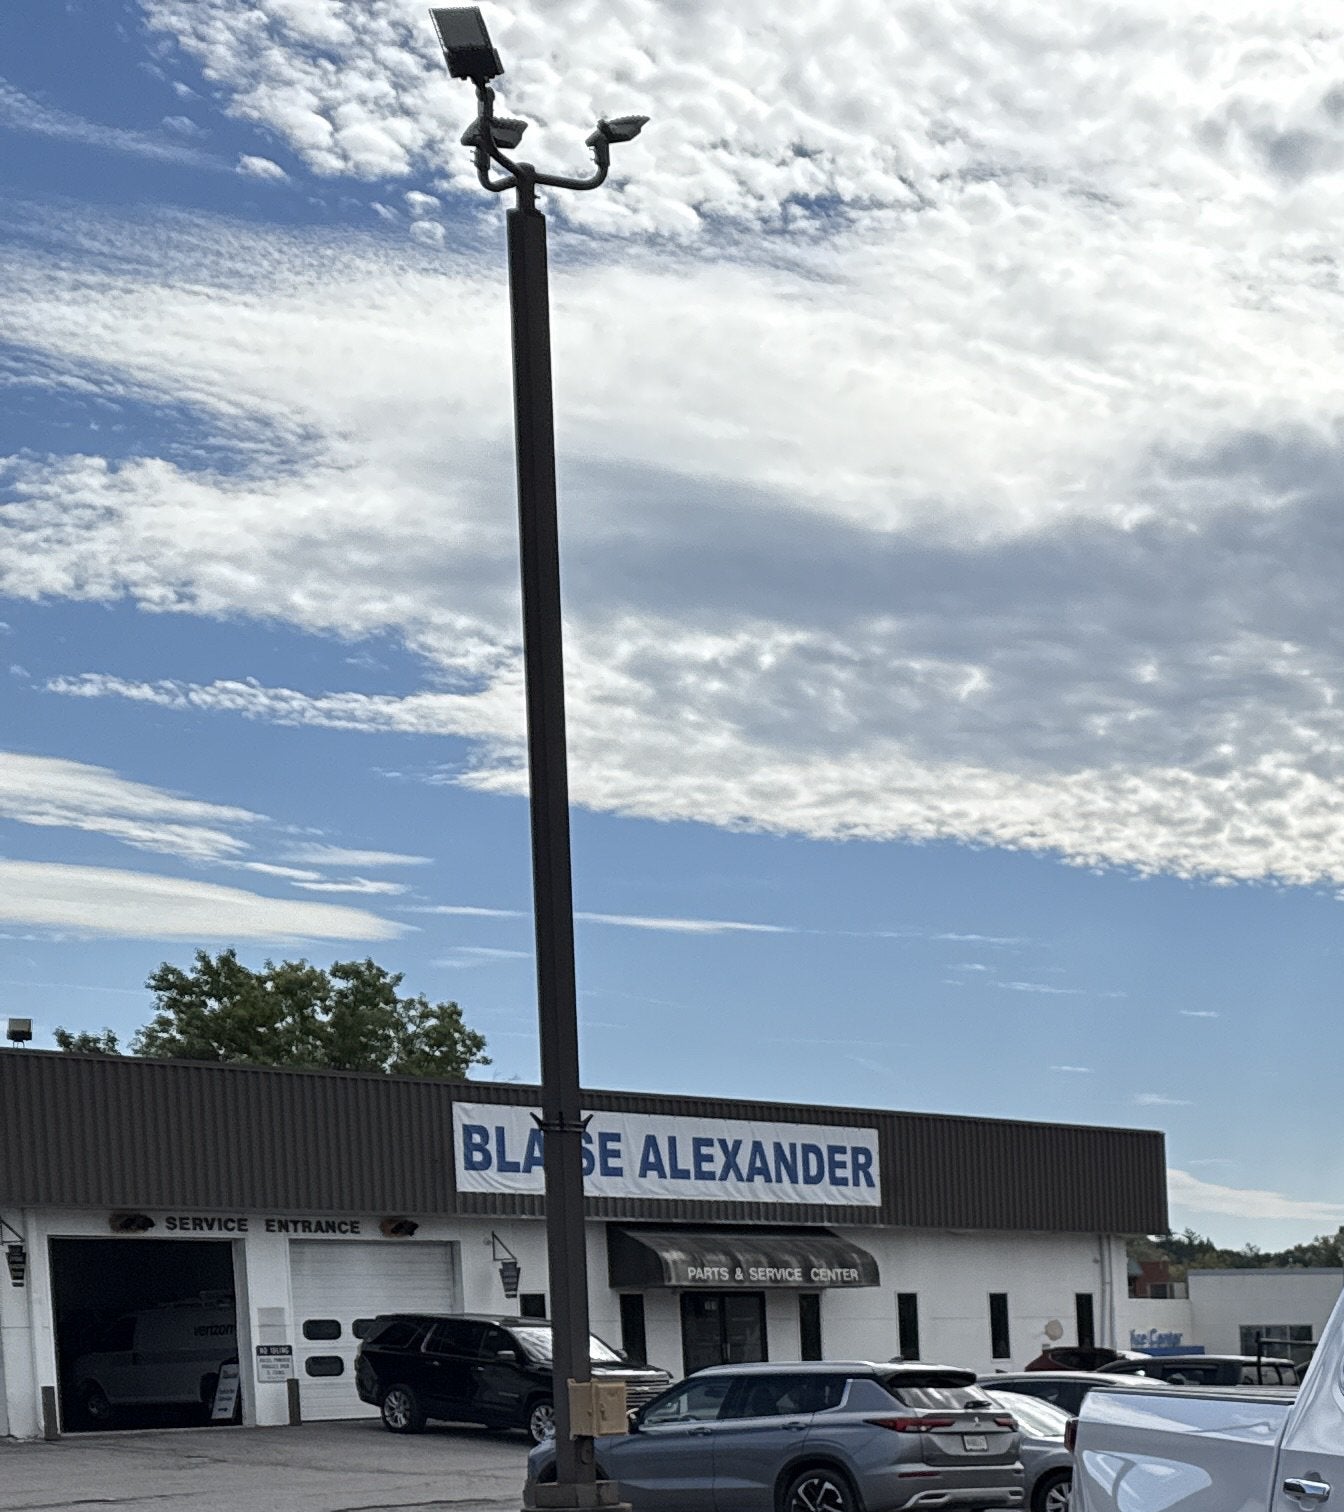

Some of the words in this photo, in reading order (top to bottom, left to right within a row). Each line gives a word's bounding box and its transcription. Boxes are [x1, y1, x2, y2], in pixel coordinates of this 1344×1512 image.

[461, 1123, 624, 1178] BLASE
[638, 1133, 876, 1189] ALEXANDER
[164, 1215, 249, 1234] SERVICE
[264, 1218, 361, 1234] ENTRANCE
[687, 1266, 729, 1281] PARTS
[735, 1267, 744, 1281] &
[748, 1267, 802, 1282] SERVICE
[810, 1267, 859, 1282] CENTER
